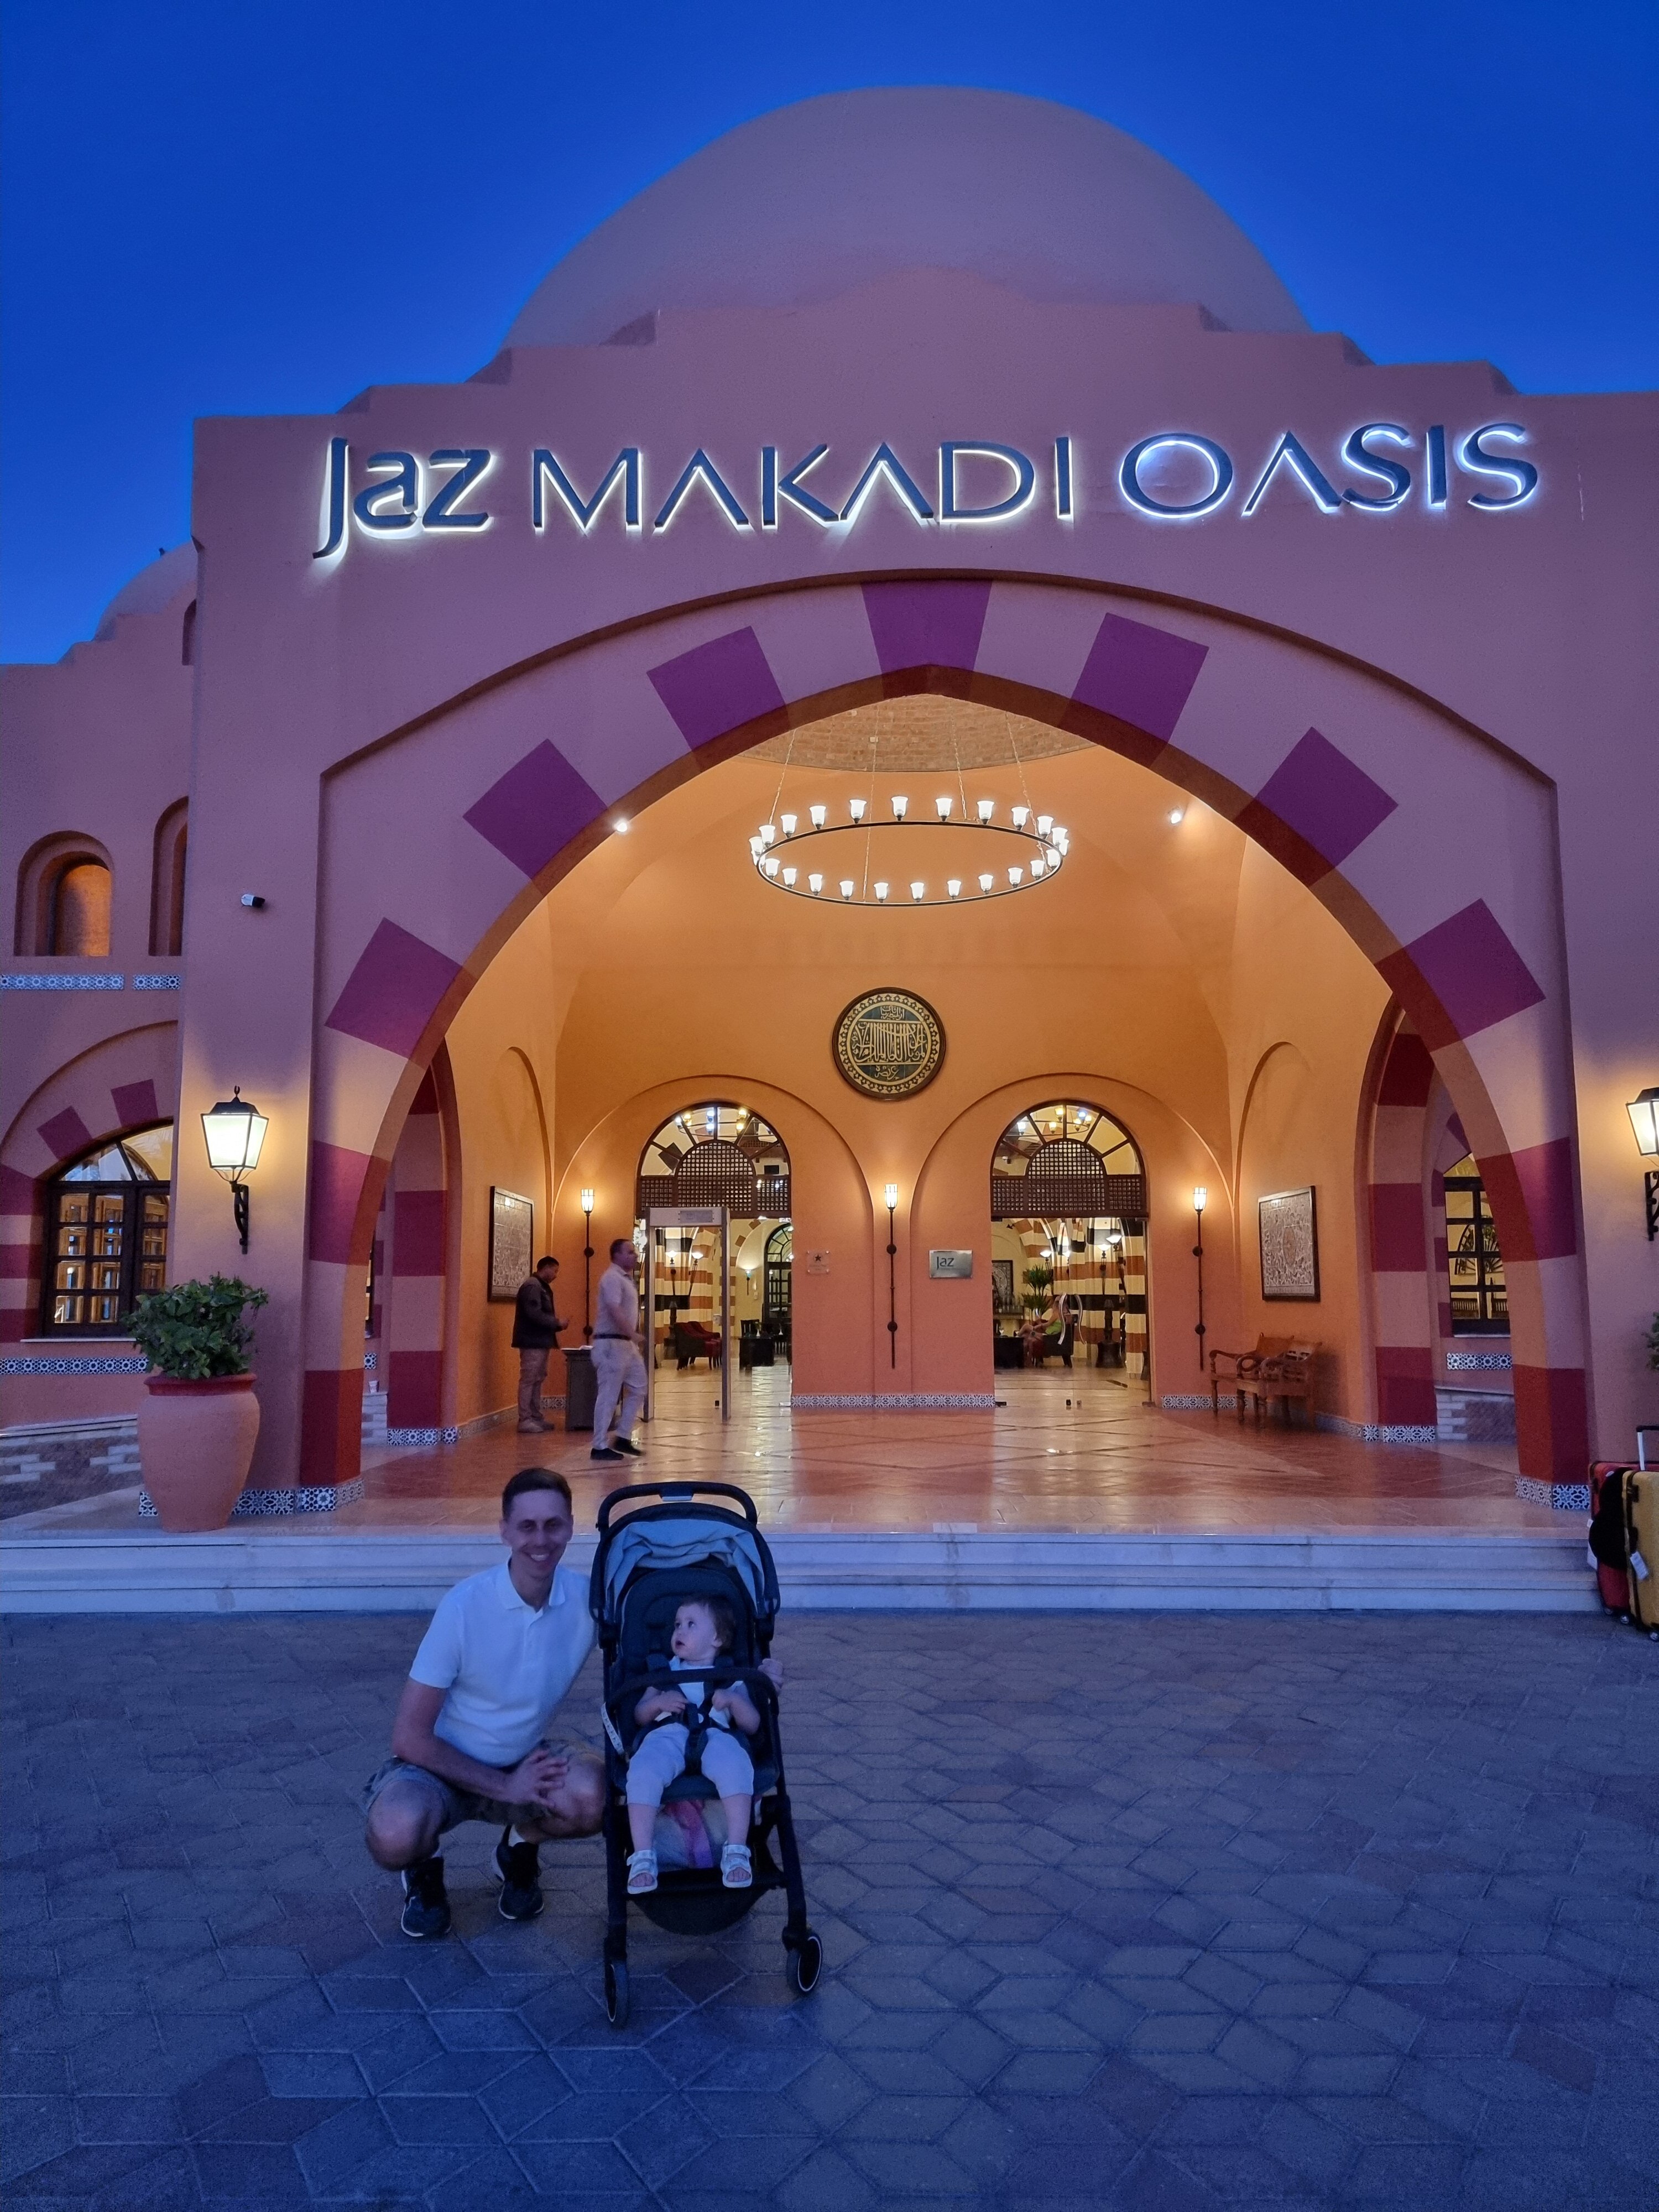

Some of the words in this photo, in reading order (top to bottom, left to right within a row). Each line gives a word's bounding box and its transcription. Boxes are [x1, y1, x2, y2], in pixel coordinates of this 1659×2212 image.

[533, 435, 1073, 530] MAKADI
[1118, 422, 1539, 519] OASIS
[936, 1256, 954, 1270] Jaz
